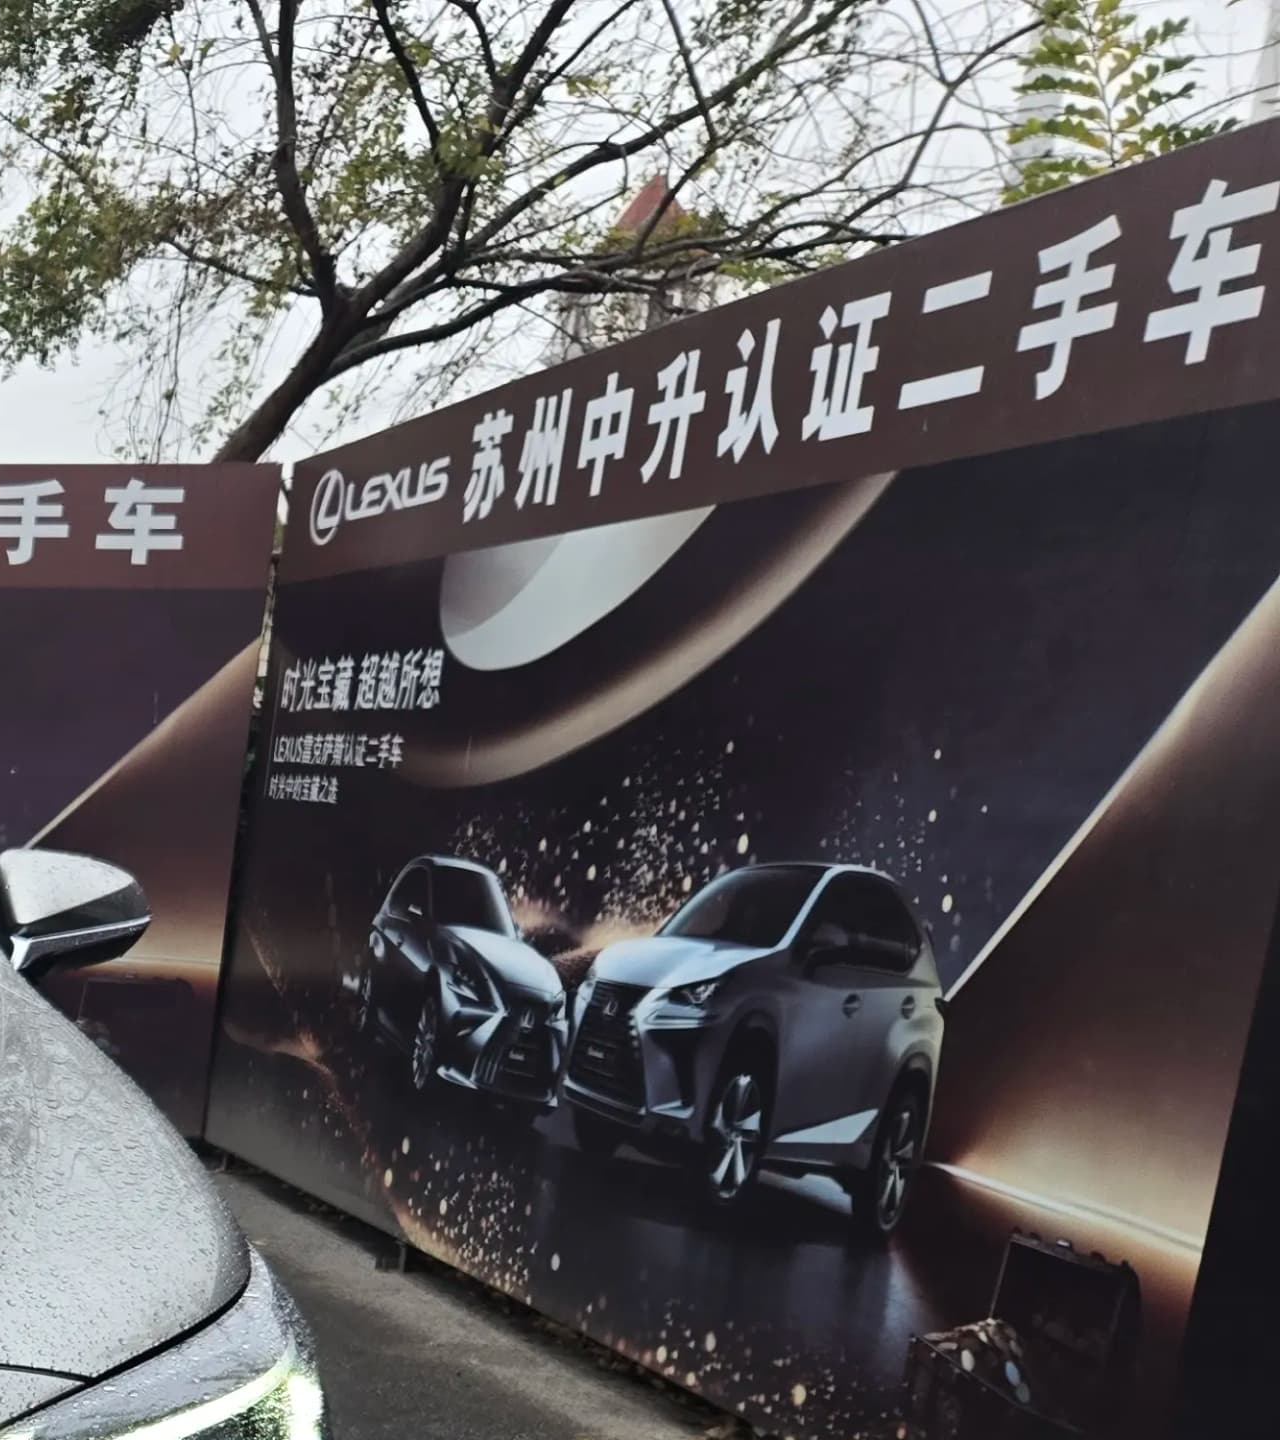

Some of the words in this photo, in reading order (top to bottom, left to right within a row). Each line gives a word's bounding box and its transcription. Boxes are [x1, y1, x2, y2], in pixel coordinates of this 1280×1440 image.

[344, 453, 452, 521] LEXUS
[462, 178, 1280, 524] 苏州中升认证二手车
[280, 653, 355, 712] 时光宝藏
[353, 648, 444, 710] 超越所想
